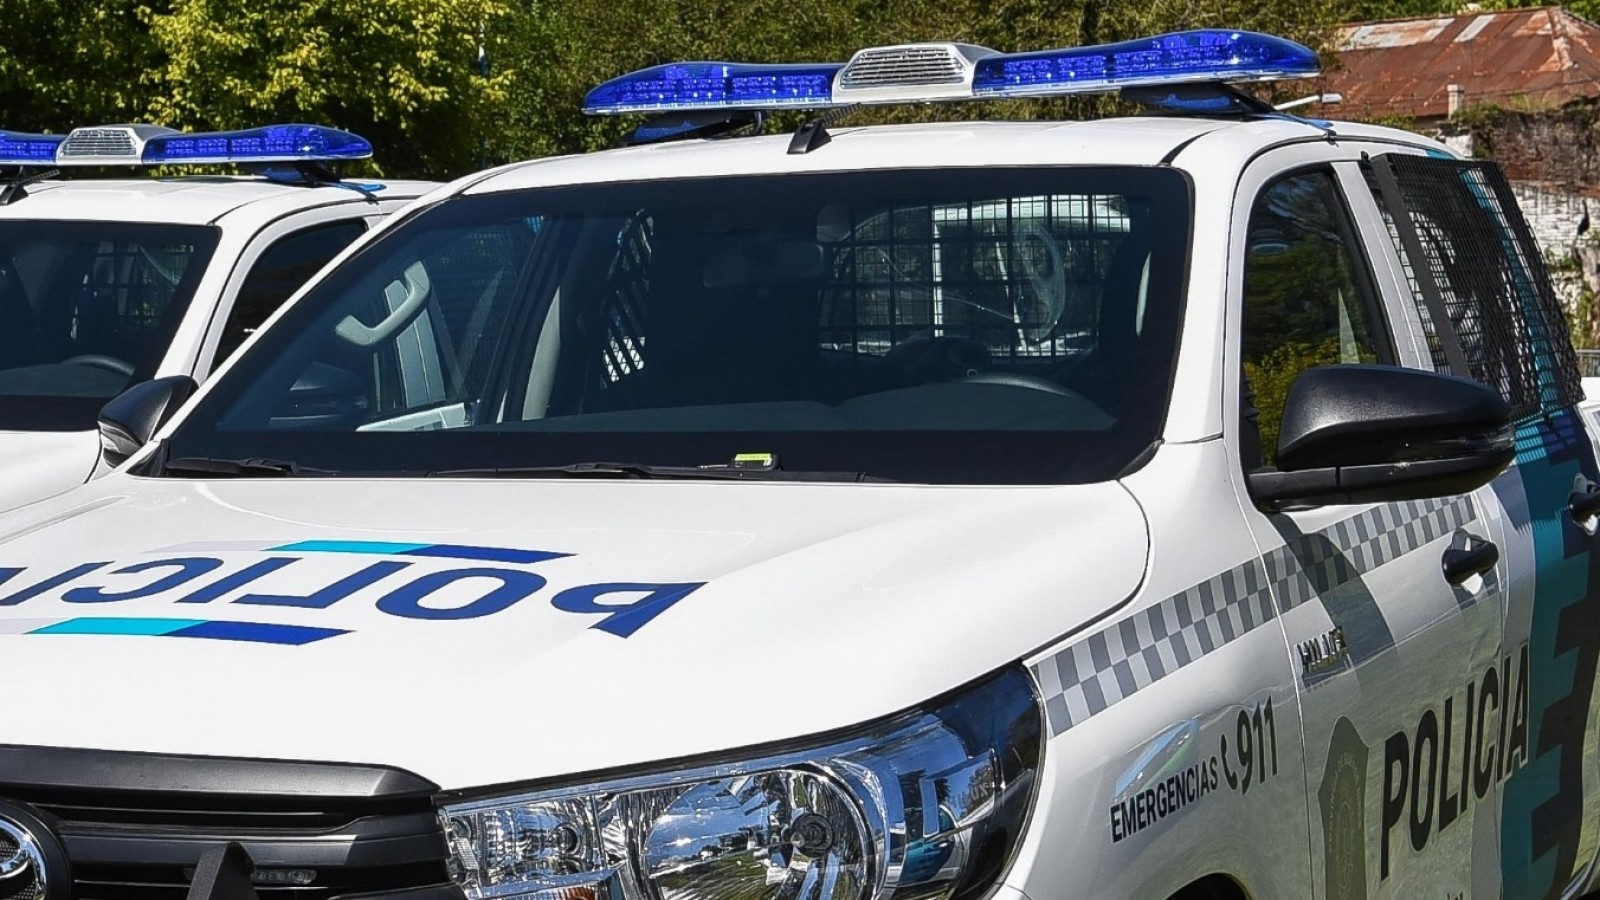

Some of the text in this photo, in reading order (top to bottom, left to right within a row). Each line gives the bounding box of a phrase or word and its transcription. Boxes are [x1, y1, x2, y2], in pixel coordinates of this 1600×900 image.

[1110, 756, 1218, 843] EMERGENCIAS
[1236, 695, 1278, 795] 911
[1381, 643, 1528, 882] POLICIA
